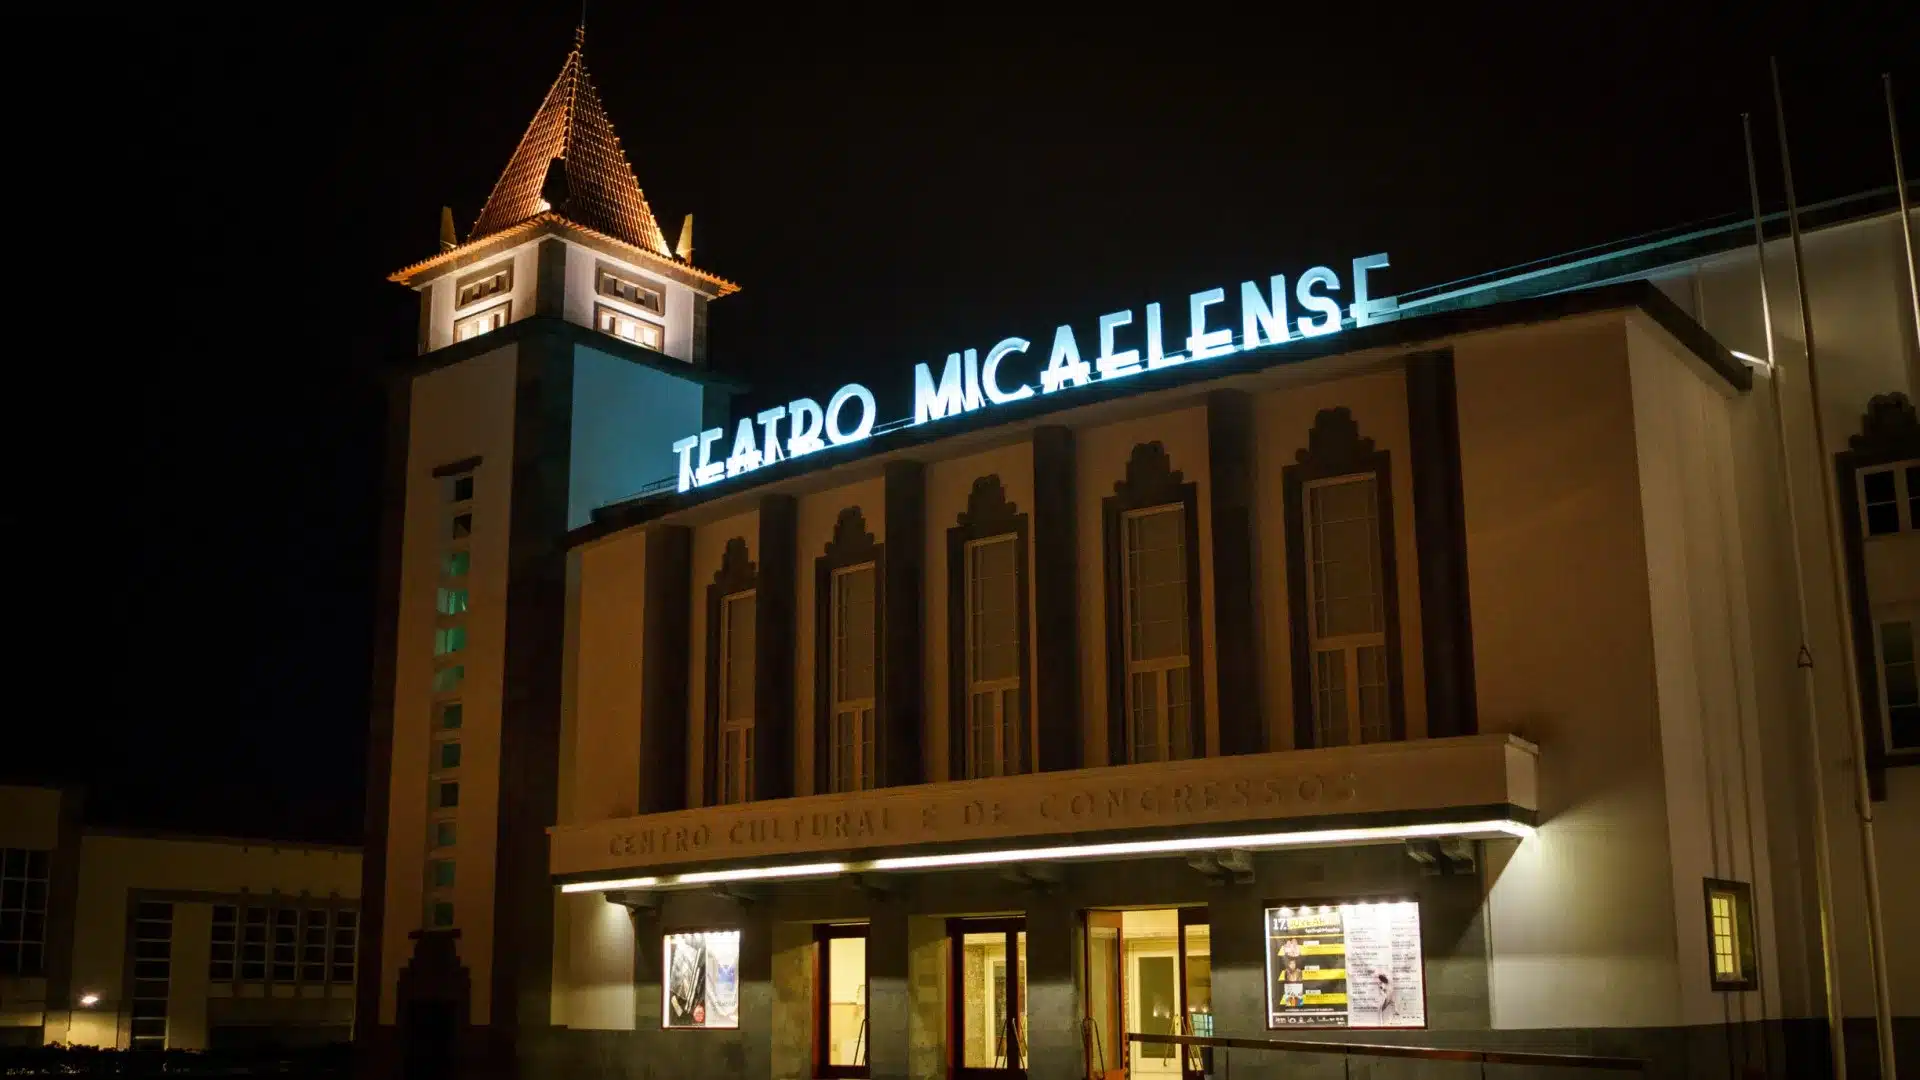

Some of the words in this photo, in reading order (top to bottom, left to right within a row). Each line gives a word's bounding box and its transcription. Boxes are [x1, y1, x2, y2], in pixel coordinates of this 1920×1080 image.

[673, 382, 877, 494] TEATRO
[913, 252, 1398, 423] MICAELENSE
[608, 823, 712, 857] CENTRO
[728, 807, 892, 845] CULTURAL
[921, 802, 939, 830] E
[963, 798, 1009, 826] DE
[1039, 771, 1357, 822] CONGRESSOS
